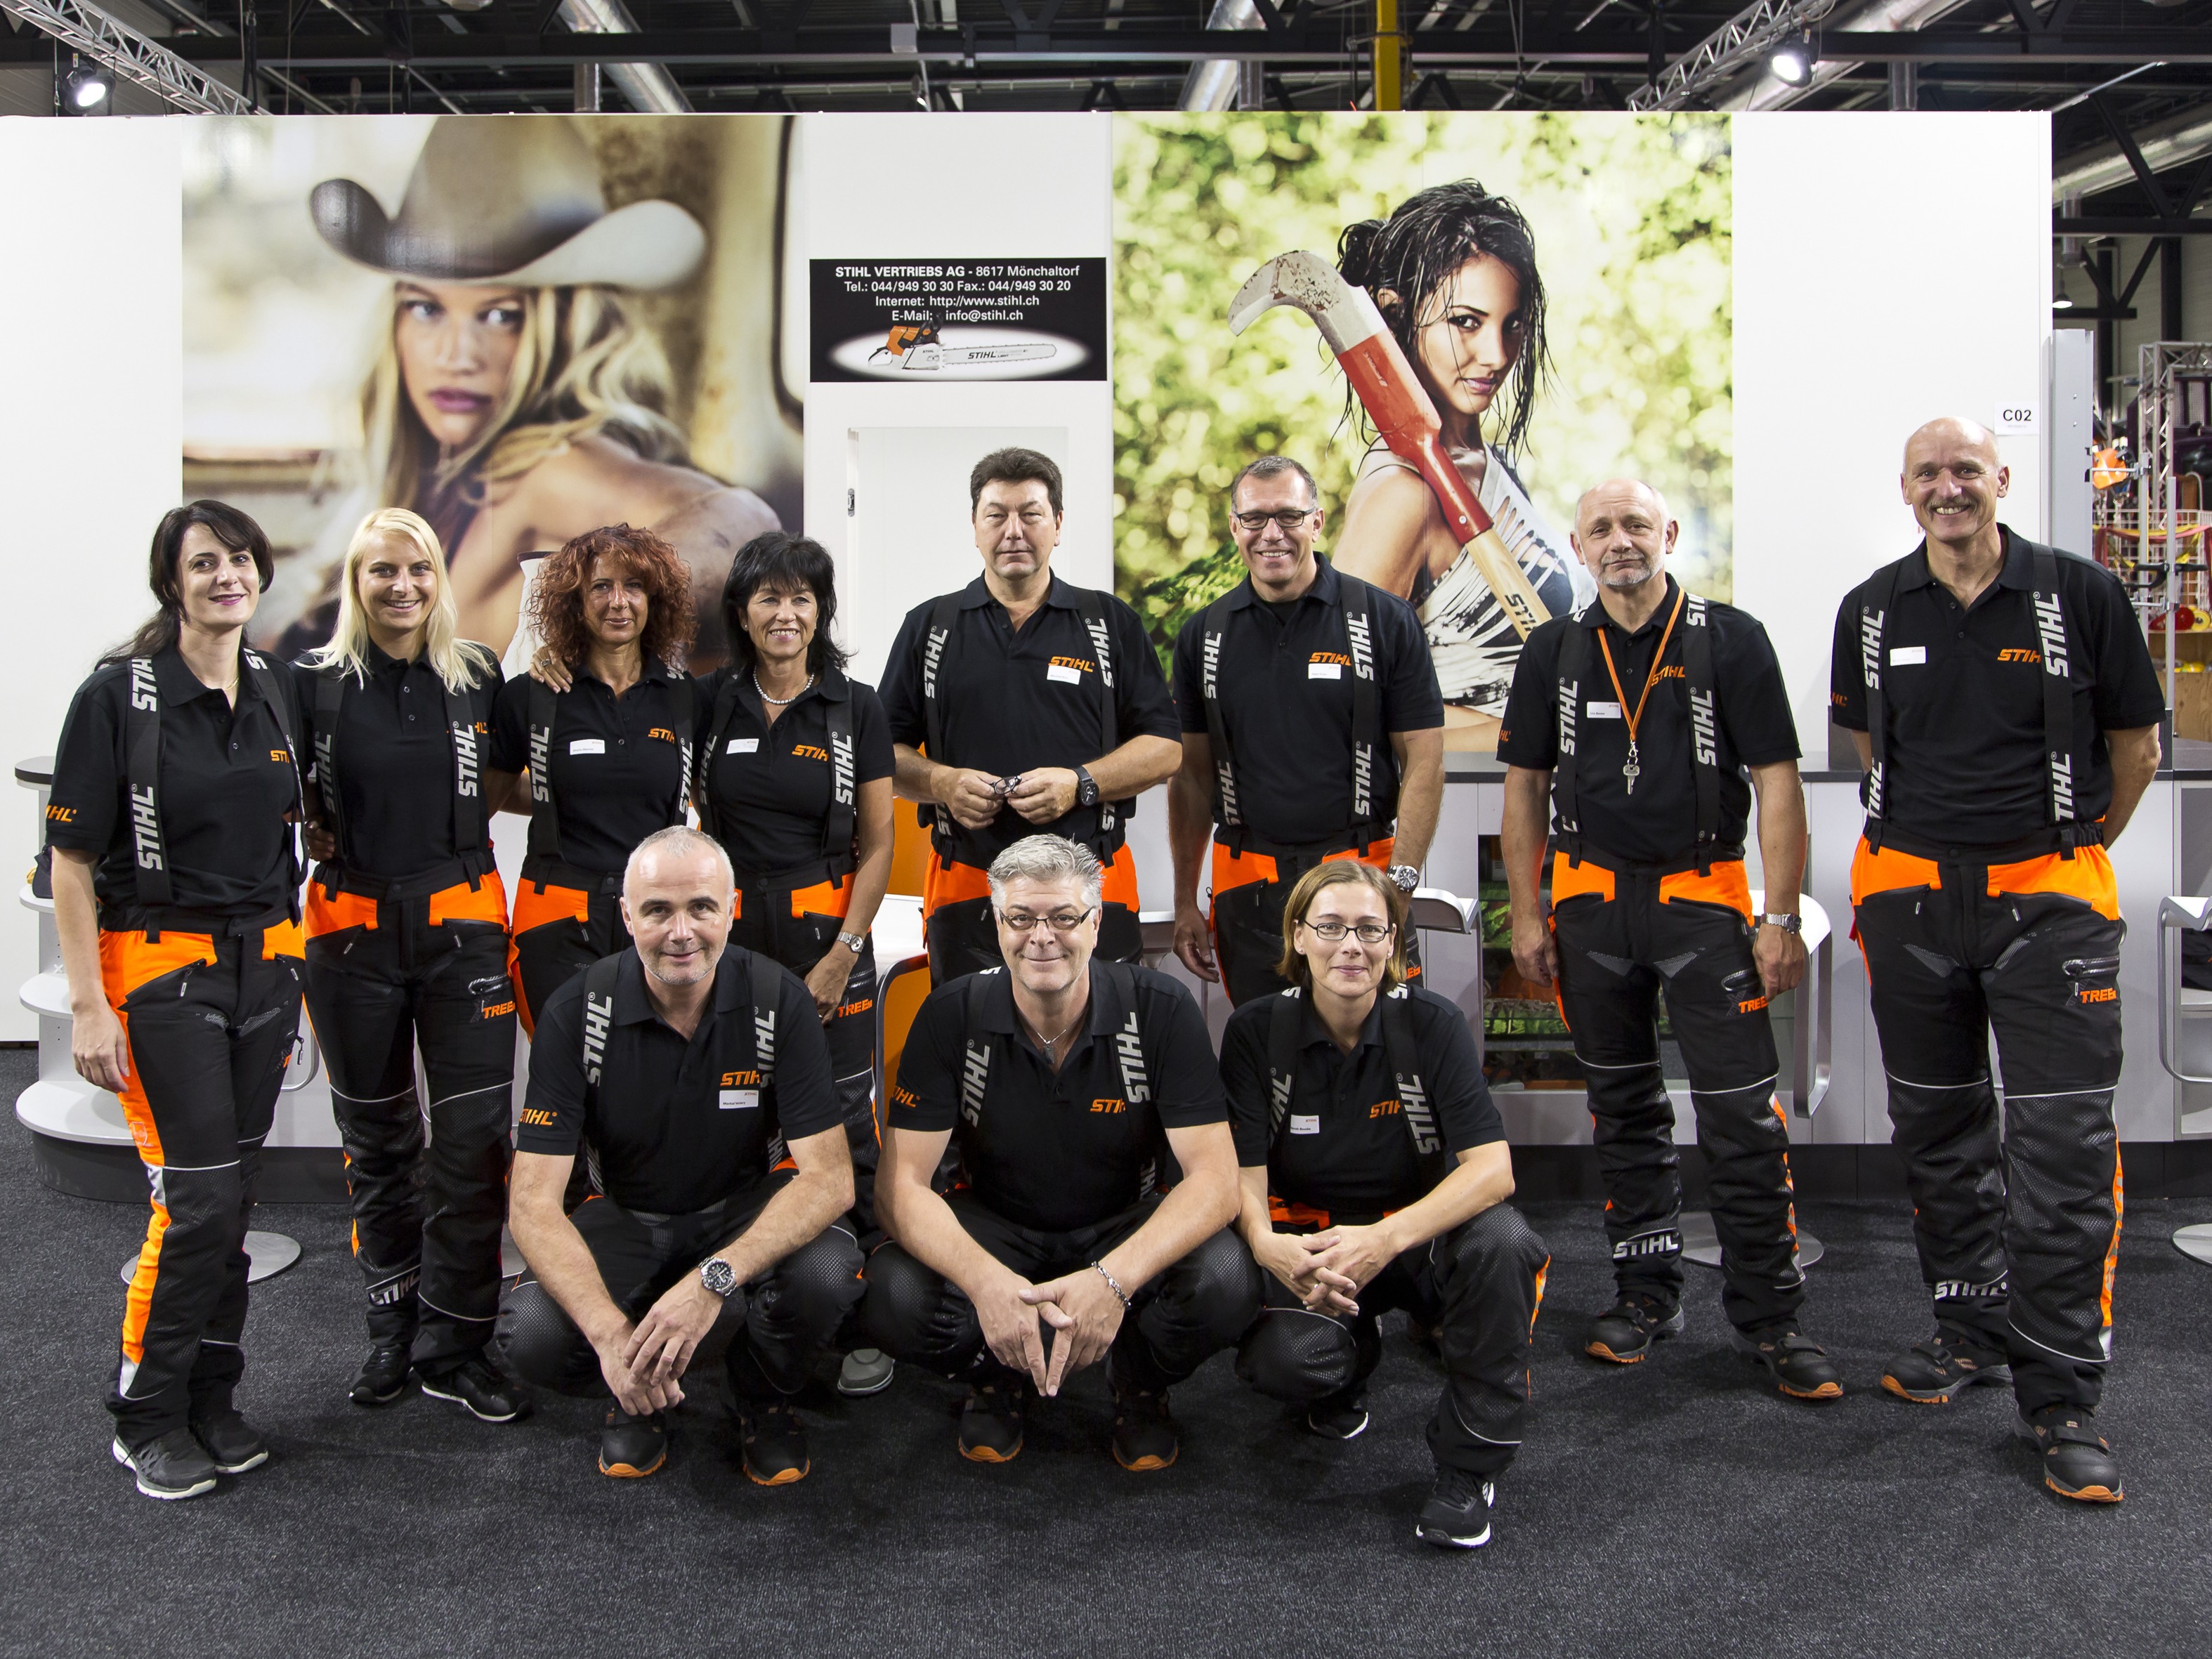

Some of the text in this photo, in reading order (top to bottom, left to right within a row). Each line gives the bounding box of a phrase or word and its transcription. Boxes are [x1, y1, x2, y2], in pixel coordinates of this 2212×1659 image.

[835, 267, 871, 277] STIHL
[874, 266, 943, 277] VERTRIEBS
[945, 266, 965, 277] AG
[976, 266, 1004, 277] 8617
[1007, 265, 1080, 277] Mönchaltorf
[844, 280, 1071, 292] Tel.: 044/949 30 30 Fax.: 044/949 30 20
[875, 295, 1040, 308] Internet: http://www.stihl.ch
[891, 310, 1023, 322] E-Mail: info@stihl.ch
[968, 351, 997, 360] STIHL
[2003, 409, 2031, 422] C02
[924, 629, 948, 699] STIHL
[1048, 656, 1094, 673] STIHL
[1088, 618, 1114, 688] STIHL
[1204, 632, 1222, 700] STIHL
[1349, 612, 1373, 681] STIHL
[1861, 610, 1884, 690] STIHL
[1997, 648, 2041, 664] STIH
[2036, 592, 2069, 678] STIHL
[1559, 680, 1578, 756] STIHL
[1691, 690, 1716, 766] STIHL
[315, 734, 336, 814] STIHL
[454, 723, 478, 797] STIHL
[530, 726, 550, 803] STIHL
[679, 742, 693, 815] STIHL
[791, 745, 829, 762] STIH
[835, 735, 854, 806] STIHL
[1354, 744, 1372, 816] STIHL
[2052, 753, 2074, 822] TIHL
[1869, 761, 1883, 822] TIHL
[133, 786, 163, 871] STIHL
[583, 995, 613, 1087] STIHL
[755, 1011, 775, 1088] STIHL
[1115, 1011, 1151, 1104] STIHL
[719, 1070, 761, 1087] STIH
[961, 1044, 990, 1128] STIHL
[1398, 1075, 1441, 1155] STIHL
[1613, 1233, 1679, 1259] STIHL
